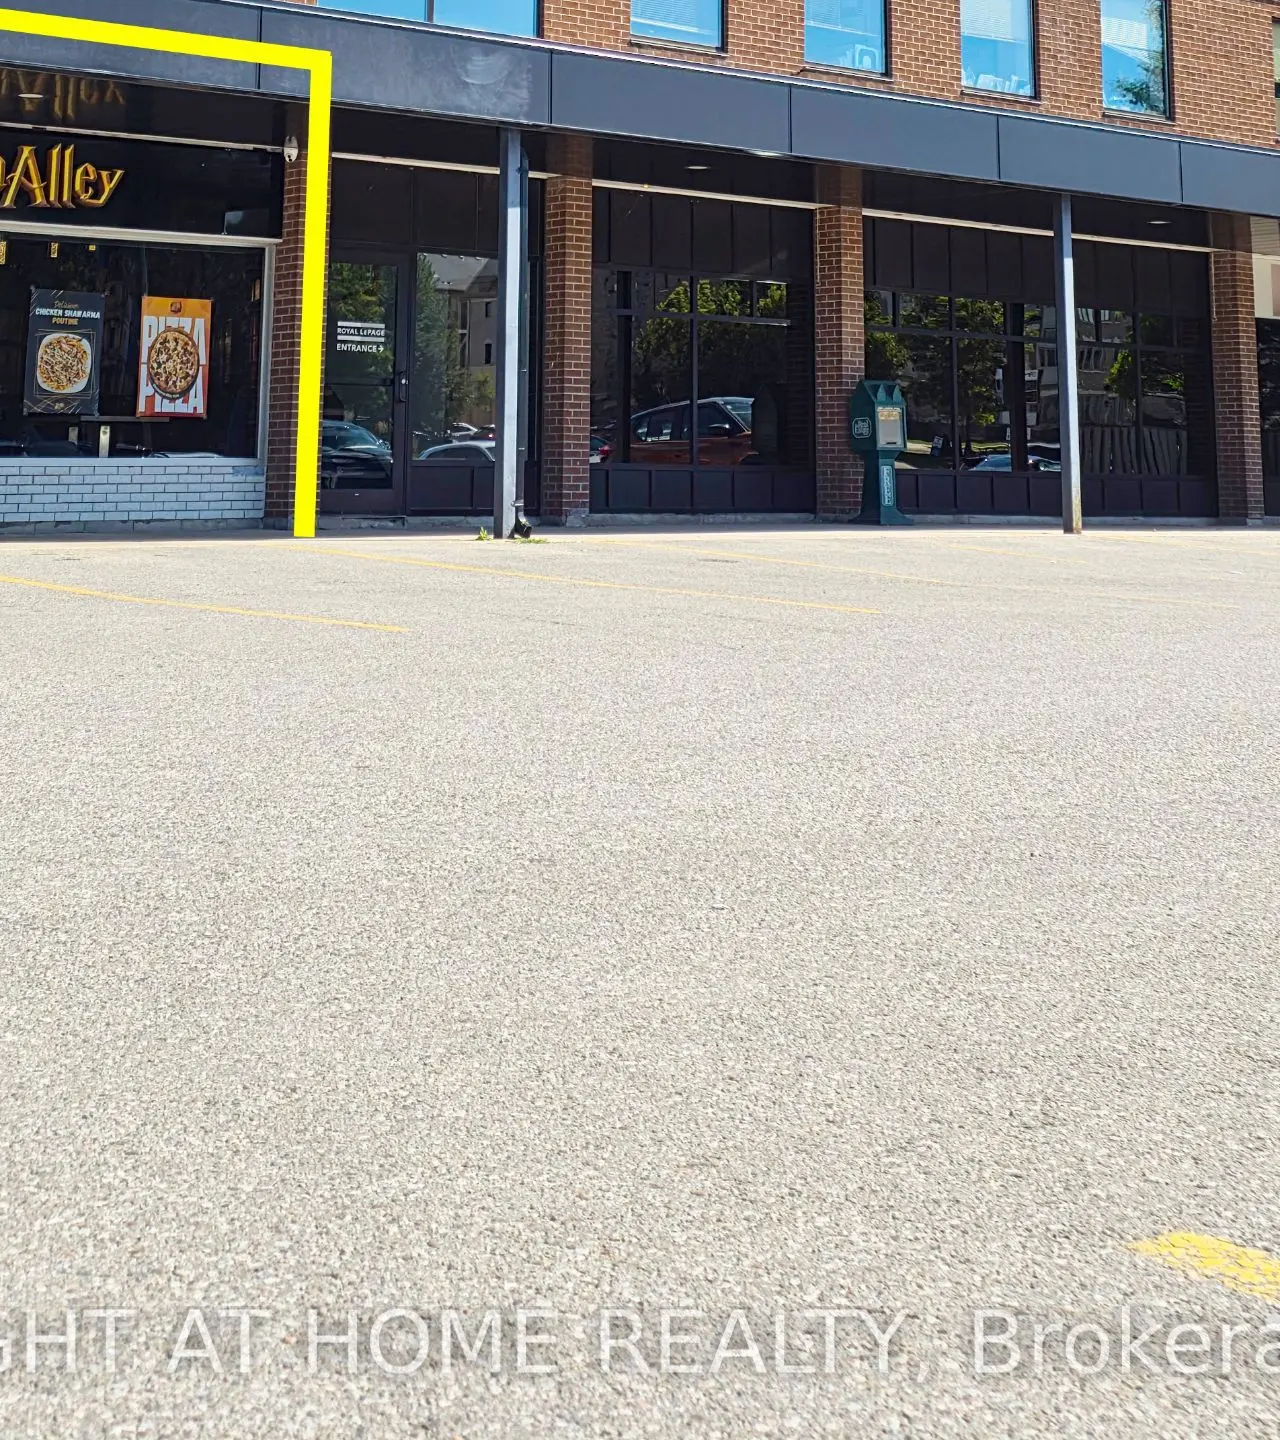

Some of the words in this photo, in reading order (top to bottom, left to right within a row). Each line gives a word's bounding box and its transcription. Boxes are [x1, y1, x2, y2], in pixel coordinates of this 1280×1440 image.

[35, 308, 63, 316] CHICKEN
[64, 309, 101, 319] SHAWARMA
[336, 343, 377, 352] ENTRANCE
